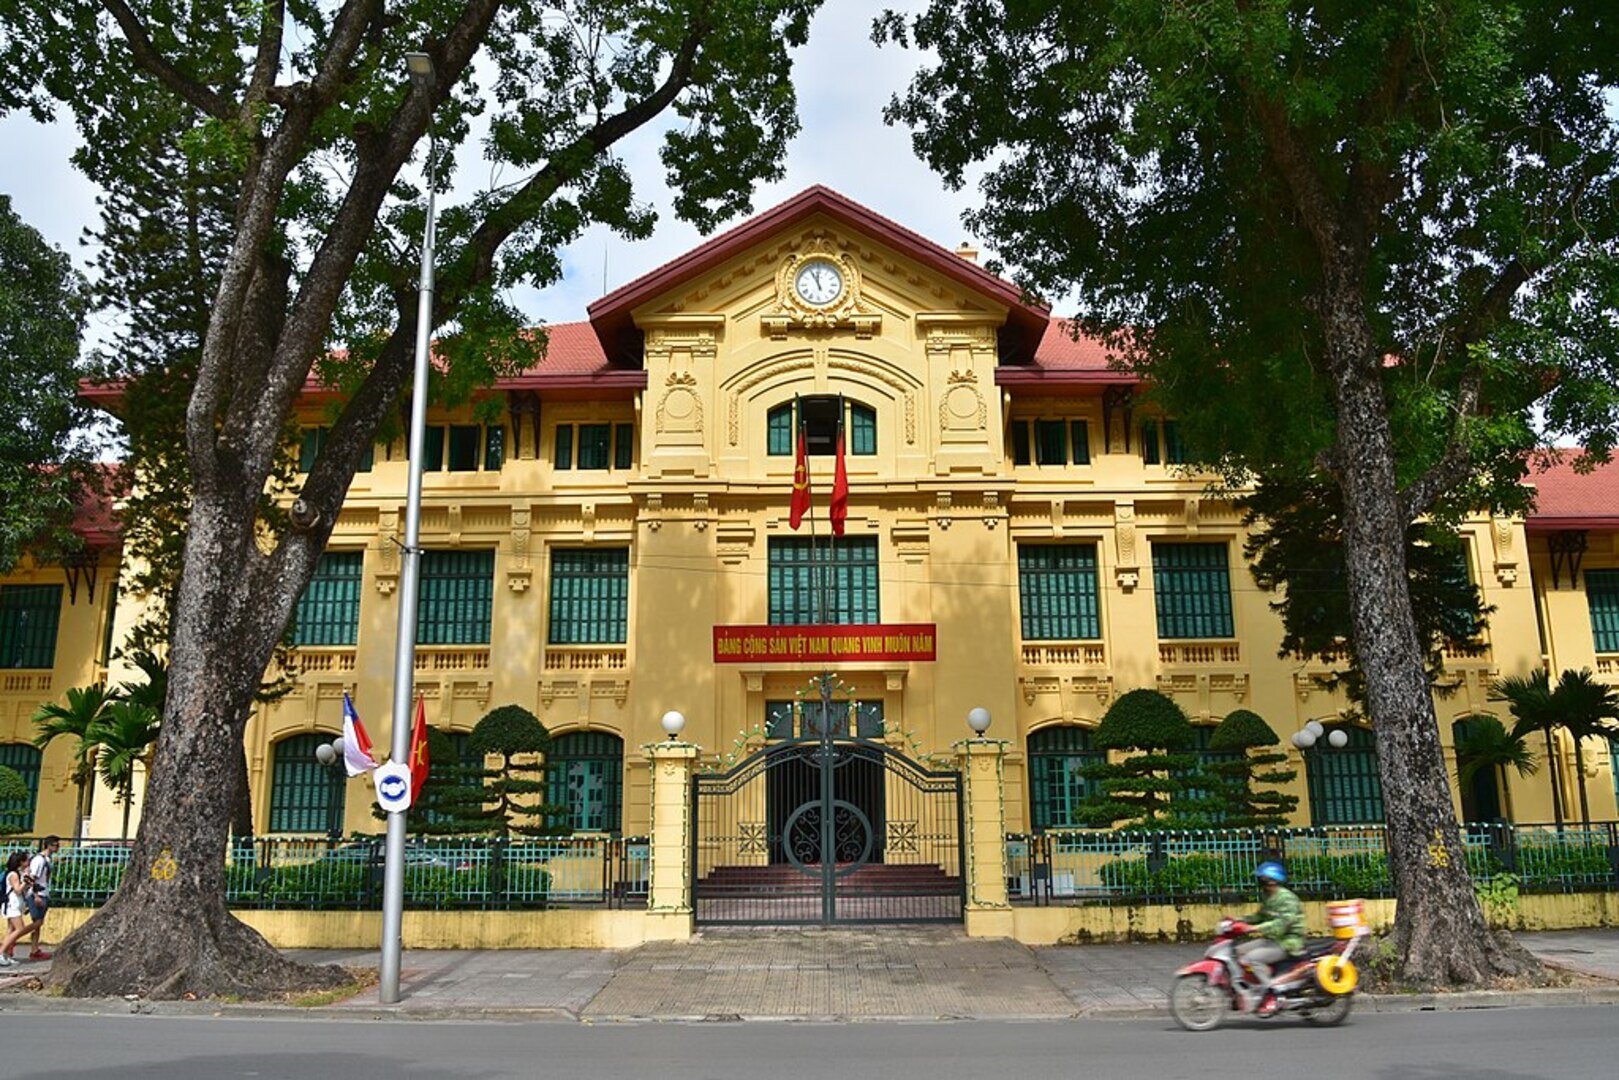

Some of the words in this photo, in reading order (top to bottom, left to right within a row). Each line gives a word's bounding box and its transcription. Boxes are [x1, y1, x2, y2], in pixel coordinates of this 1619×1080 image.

[788, 633, 807, 658] VIỆT
[808, 637, 830, 654] NAM
[831, 637, 861, 656] QUANG
[862, 637, 883, 653] VINH
